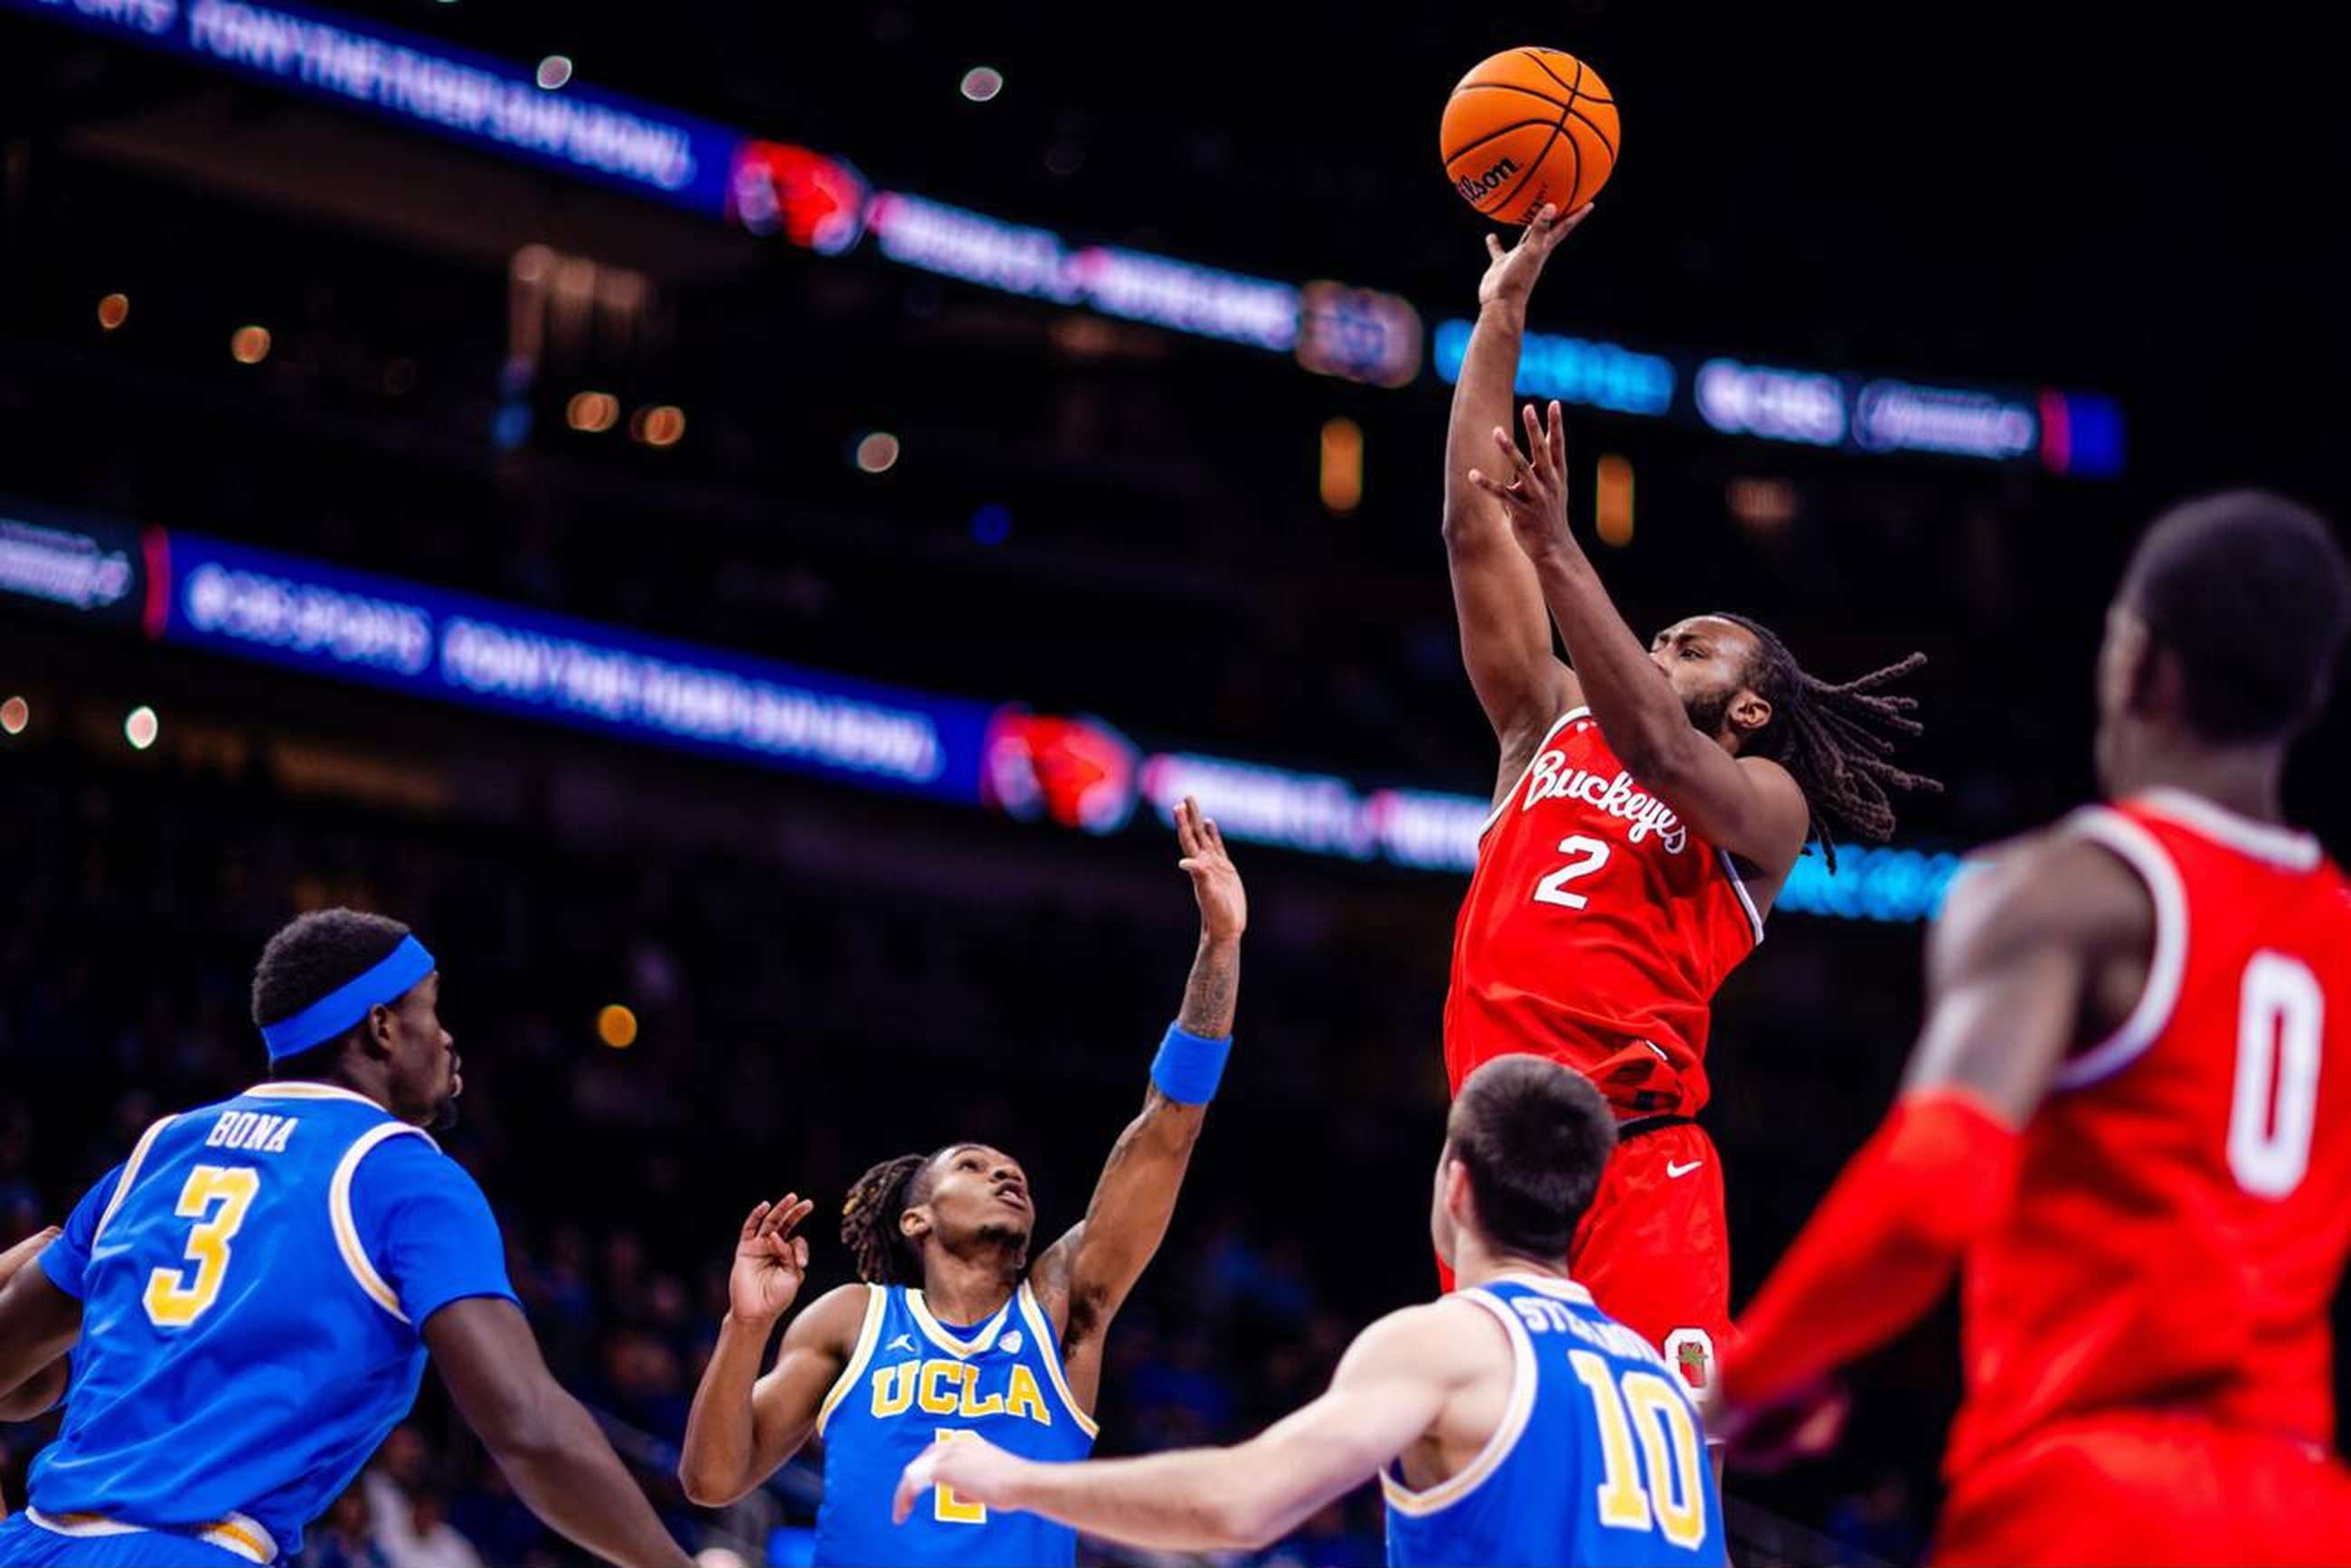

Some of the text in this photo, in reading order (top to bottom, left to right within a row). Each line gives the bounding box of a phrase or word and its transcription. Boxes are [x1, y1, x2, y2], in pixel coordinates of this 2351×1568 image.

[1522, 750, 1686, 855] Buckeyes
[1534, 835, 1610, 911] 2
[2226, 949, 2325, 1201] 0
[205, 1110, 298, 1153] BONA
[142, 1165, 260, 1327] 3
[871, 1359, 1052, 1426] UCLA
[1567, 1348, 1706, 1551] 10
